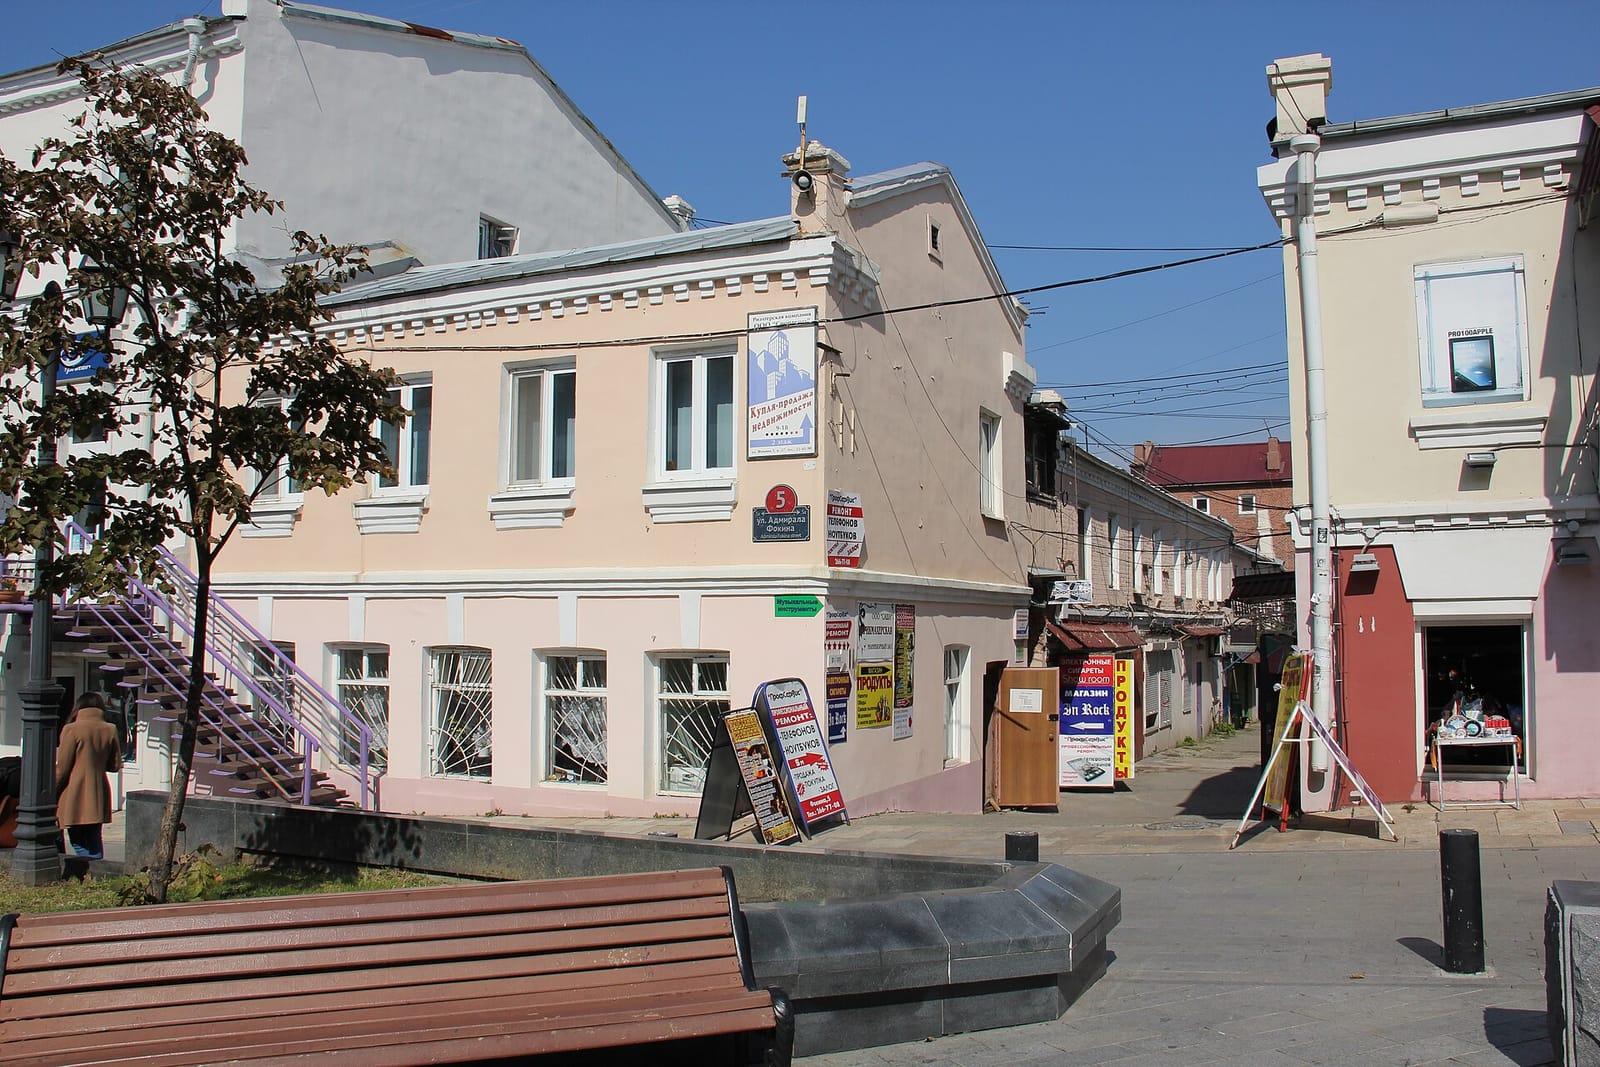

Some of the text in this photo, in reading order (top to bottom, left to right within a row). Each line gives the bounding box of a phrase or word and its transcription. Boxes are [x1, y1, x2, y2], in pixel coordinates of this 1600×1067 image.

[750, 392, 813, 418] Купля-продажа
[752, 401, 812, 432] недвижимости
[776, 490, 786, 508] 5
[756, 518, 766, 526] ул.
[856, 674, 892, 692] ПРОДУКТЫ
[1063, 703, 1110, 716] In Rock
[776, 712, 812, 726] РЕМОНТ:
[1116, 660, 1128, 778] ПРОДУКТЫ
